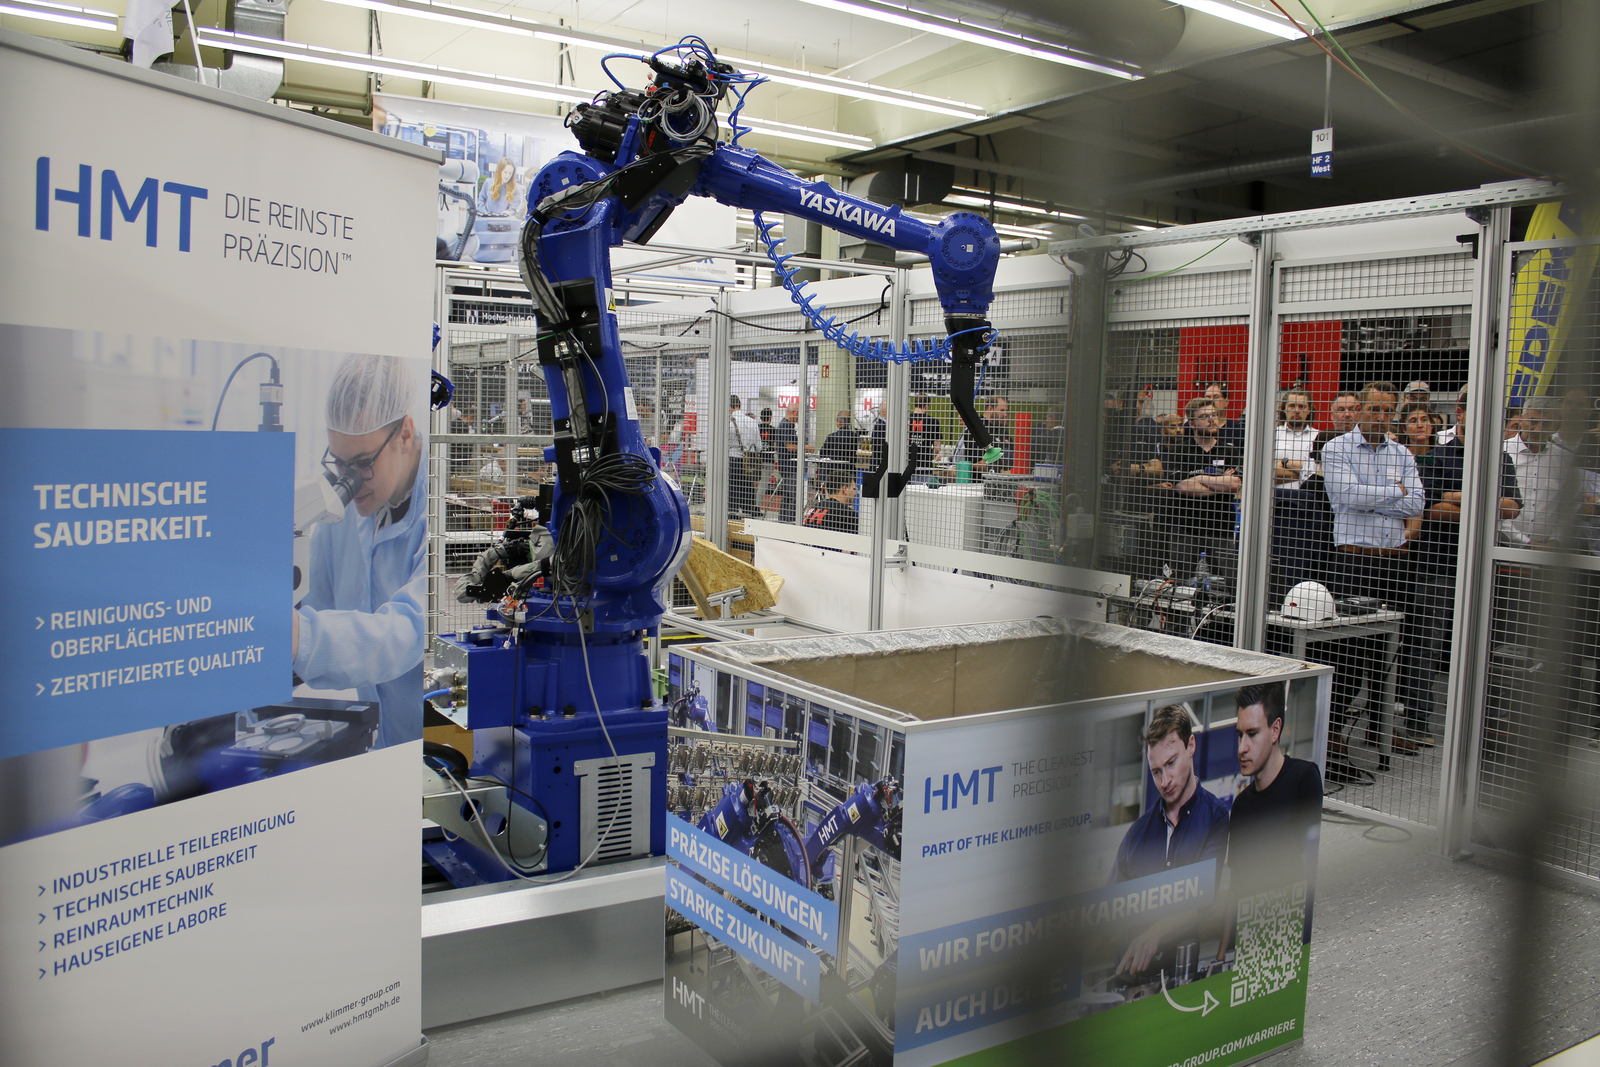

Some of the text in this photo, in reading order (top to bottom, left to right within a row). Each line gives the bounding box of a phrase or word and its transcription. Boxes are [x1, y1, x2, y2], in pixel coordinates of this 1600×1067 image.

[1312, 155, 1330, 165] HF 2
[1316, 132, 1329, 142] 101
[1312, 164, 1331, 174] West
[35, 156, 208, 253] HMT
[225, 193, 354, 241] DIE REINSTE
[800, 187, 896, 237] YASKAWA
[34, 481, 207, 510] TECHNISCHE
[34, 515, 211, 549] SAUBERKEIT.
[51, 597, 212, 630] REINIGUNGS- UND
[51, 616, 255, 659] OBERFLÄCHENTECHNIK
[51, 645, 264, 696] ZERTIFIZIERTE QUALITÄT
[1012, 750, 1095, 777] THE CLEANEST
[924, 765, 1003, 814] HMT
[53, 810, 296, 895] INDUSTRIELLE TEILEREINIGUNG
[817, 814, 838, 845] HMT
[922, 813, 1092, 858] PART OF THE KLIMMER GROUP.
[53, 845, 258, 922] TECHNISCHE SAUBERKEIT
[671, 826, 829, 941] PRÄZISE LÖSUNGEN,
[53, 883, 214, 949] REINRAUMTECHNIK
[670, 877, 808, 986] STARKE ZUKUNFT.
[919, 937, 969, 972] WIR
[1080, 876, 1204, 926] KARRIEREN.
[53, 902, 228, 977] HAUSEIGENE LABORE
[301, 980, 401, 1033] www.klimmer-group.com
[329, 996, 401, 1035] www.hmtgmbh.de
[672, 976, 706, 1020] HMT
[915, 990, 986, 1034] AUCH
